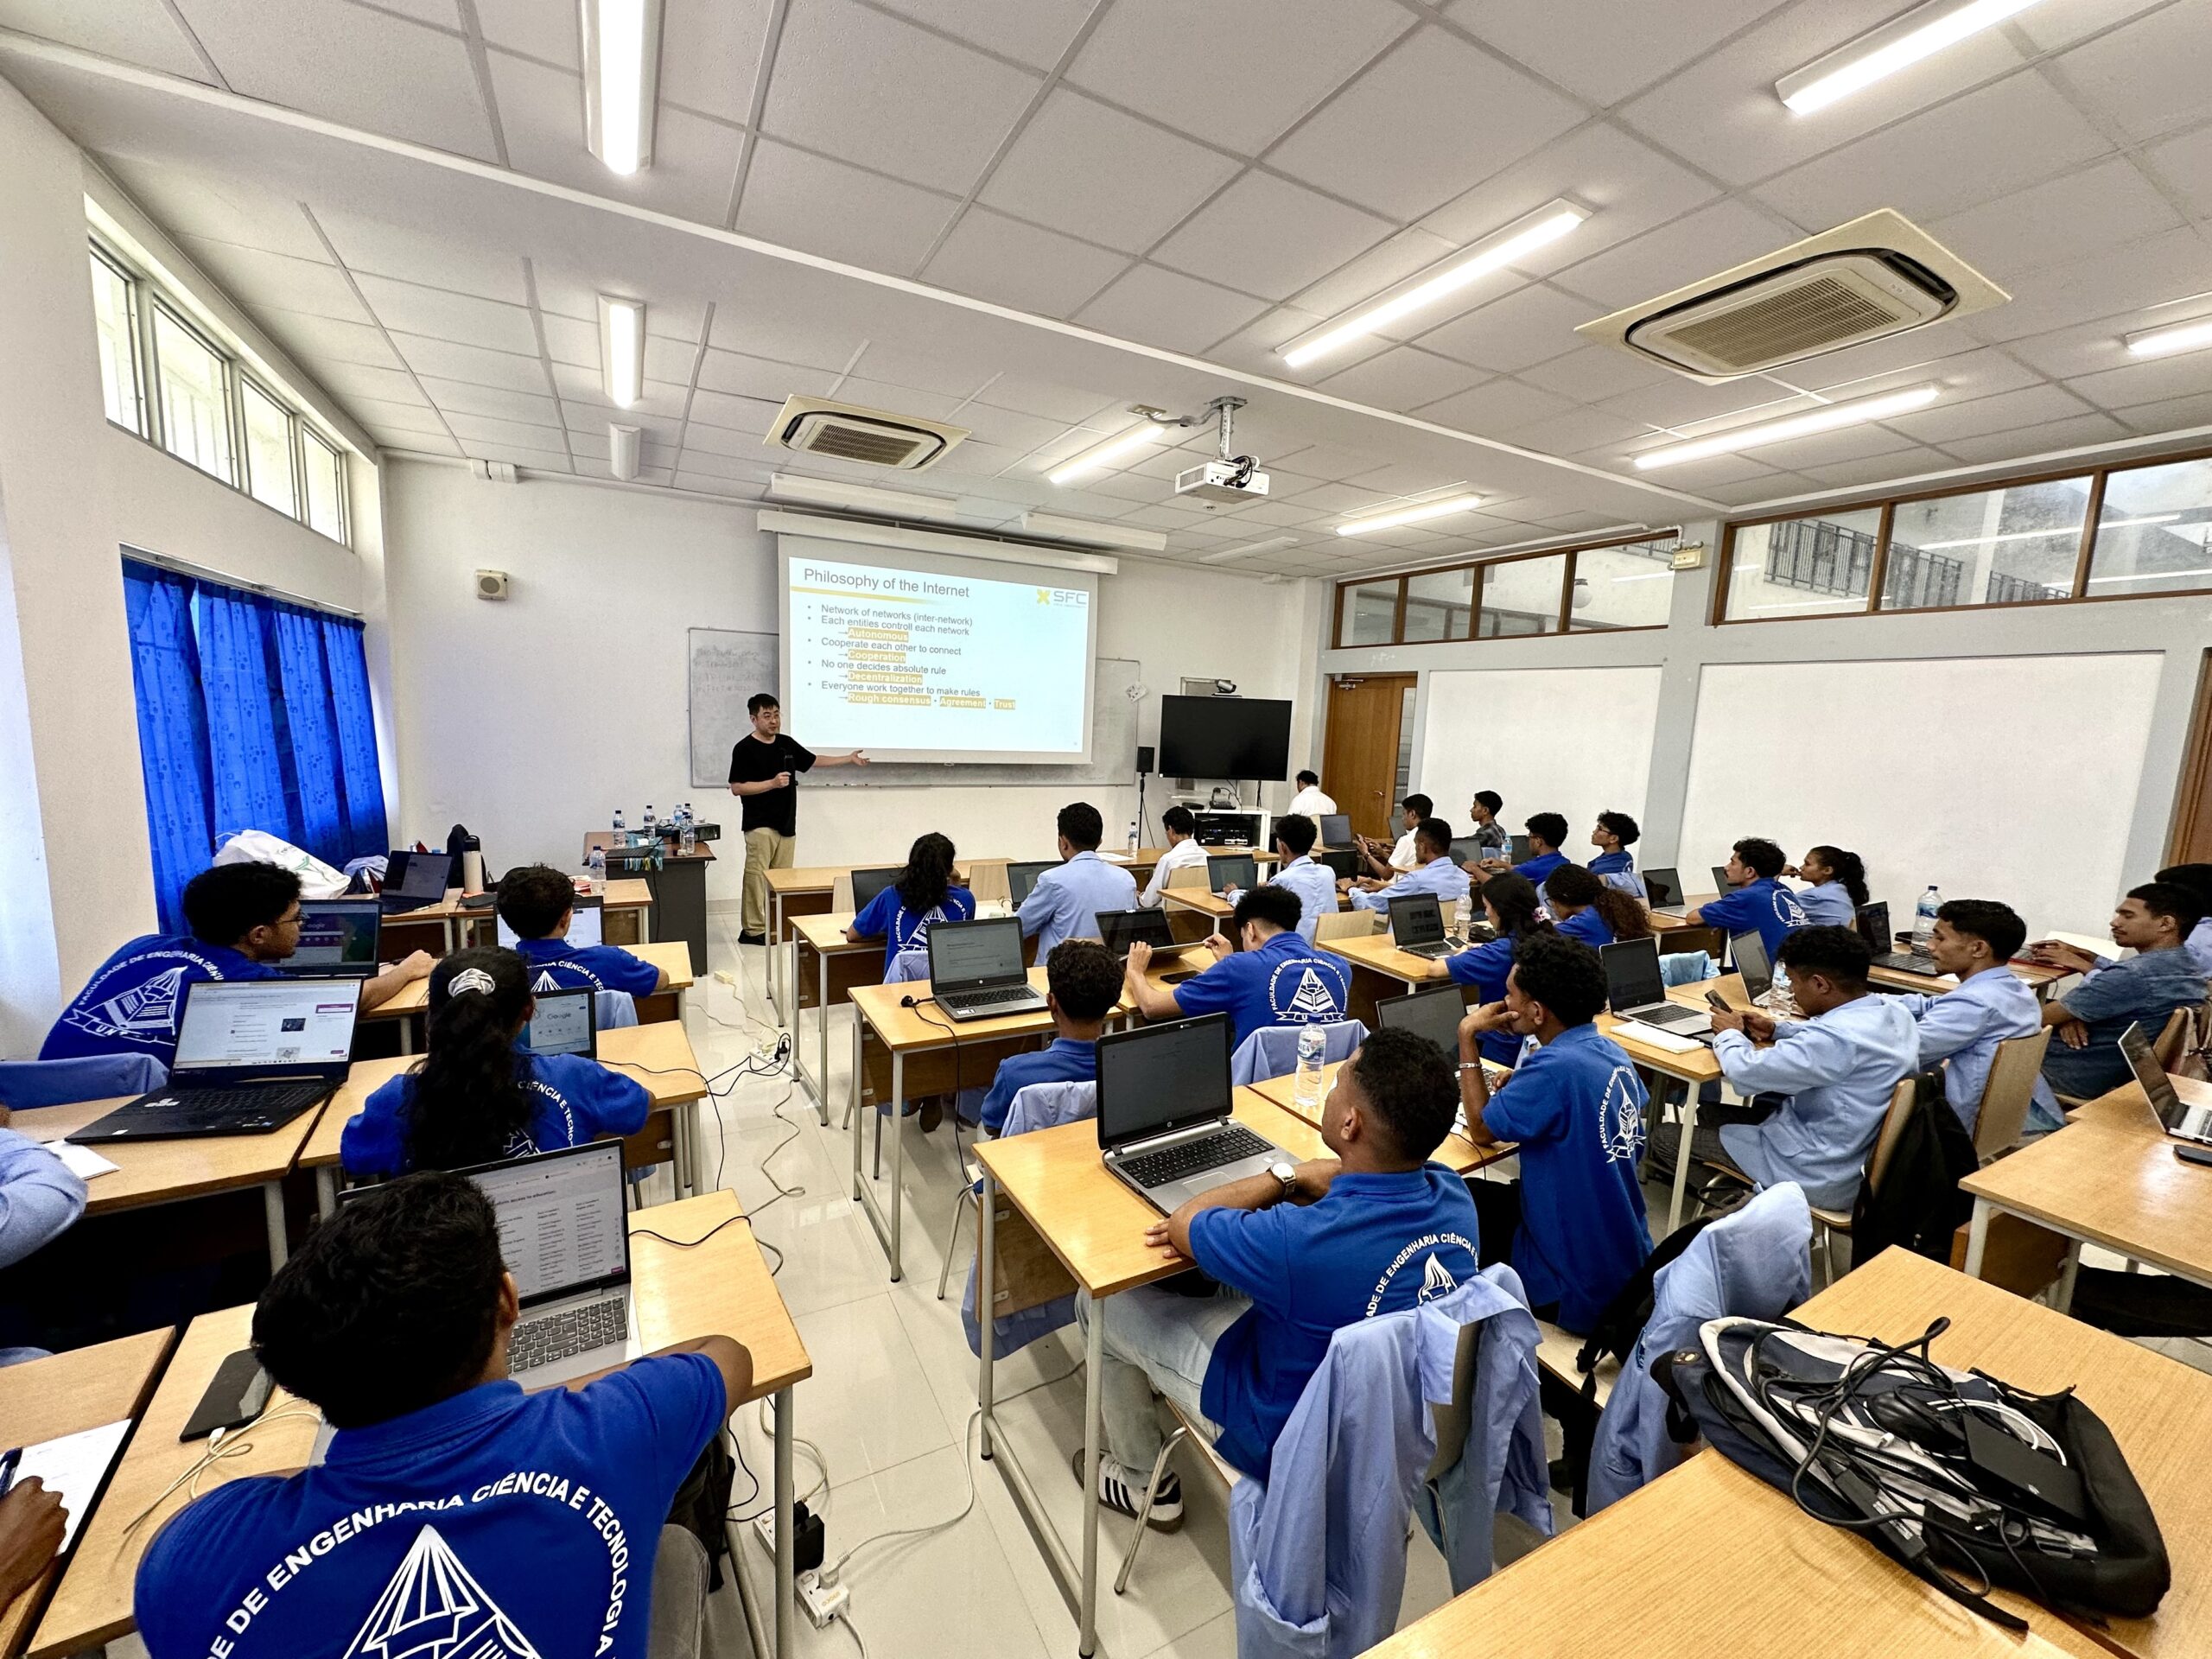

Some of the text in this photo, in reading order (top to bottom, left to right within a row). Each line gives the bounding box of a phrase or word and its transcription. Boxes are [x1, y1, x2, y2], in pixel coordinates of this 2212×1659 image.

[804, 568, 969, 598] Philosophy of the Internet
[1053, 591, 1087, 605] SFC
[821, 605, 973, 626] Network of networks (inter-network)
[821, 615, 845, 626] Each
[847, 617, 880, 629] entities
[914, 624, 936, 633] each
[938, 626, 969, 636] network
[848, 628, 909, 642] Autonomous
[821, 637, 962, 656] Cooperate each other to connect
[848, 650, 906, 663] Cooperation
[821, 659, 835, 668] No
[856, 662, 891, 672] decides
[893, 664, 929, 674] absolute
[931, 666, 947, 675] rule
[848, 671, 923, 685] Decentralization
[821, 681, 981, 697] Everyone work together to make rules
[848, 693, 880, 704] Rough
[881, 696, 931, 706] consensus
[557, 960, 589, 977] CIÊNCIA
[78, 960, 128, 1006] FACULDADE
[1268, 975, 1278, 1011] FACULDADE
[1274, 966, 1282, 976] DE
[559, 1099, 568, 1109] E
[1599, 1098, 1609, 1149] FACULDADE
[1375, 1276, 1390, 1294] DE
[1385, 1234, 1440, 1278] ENGENHARIA
[1440, 1232, 1471, 1252] CIÊNCIA
[226, 1587, 269, 1636] DE
[266, 1497, 464, 1592] ENGENHARIA
[470, 1471, 570, 1503] CIÊNCIA
[569, 1483, 588, 1510] E
[584, 1496, 630, 1658] TECNOLOGIA
